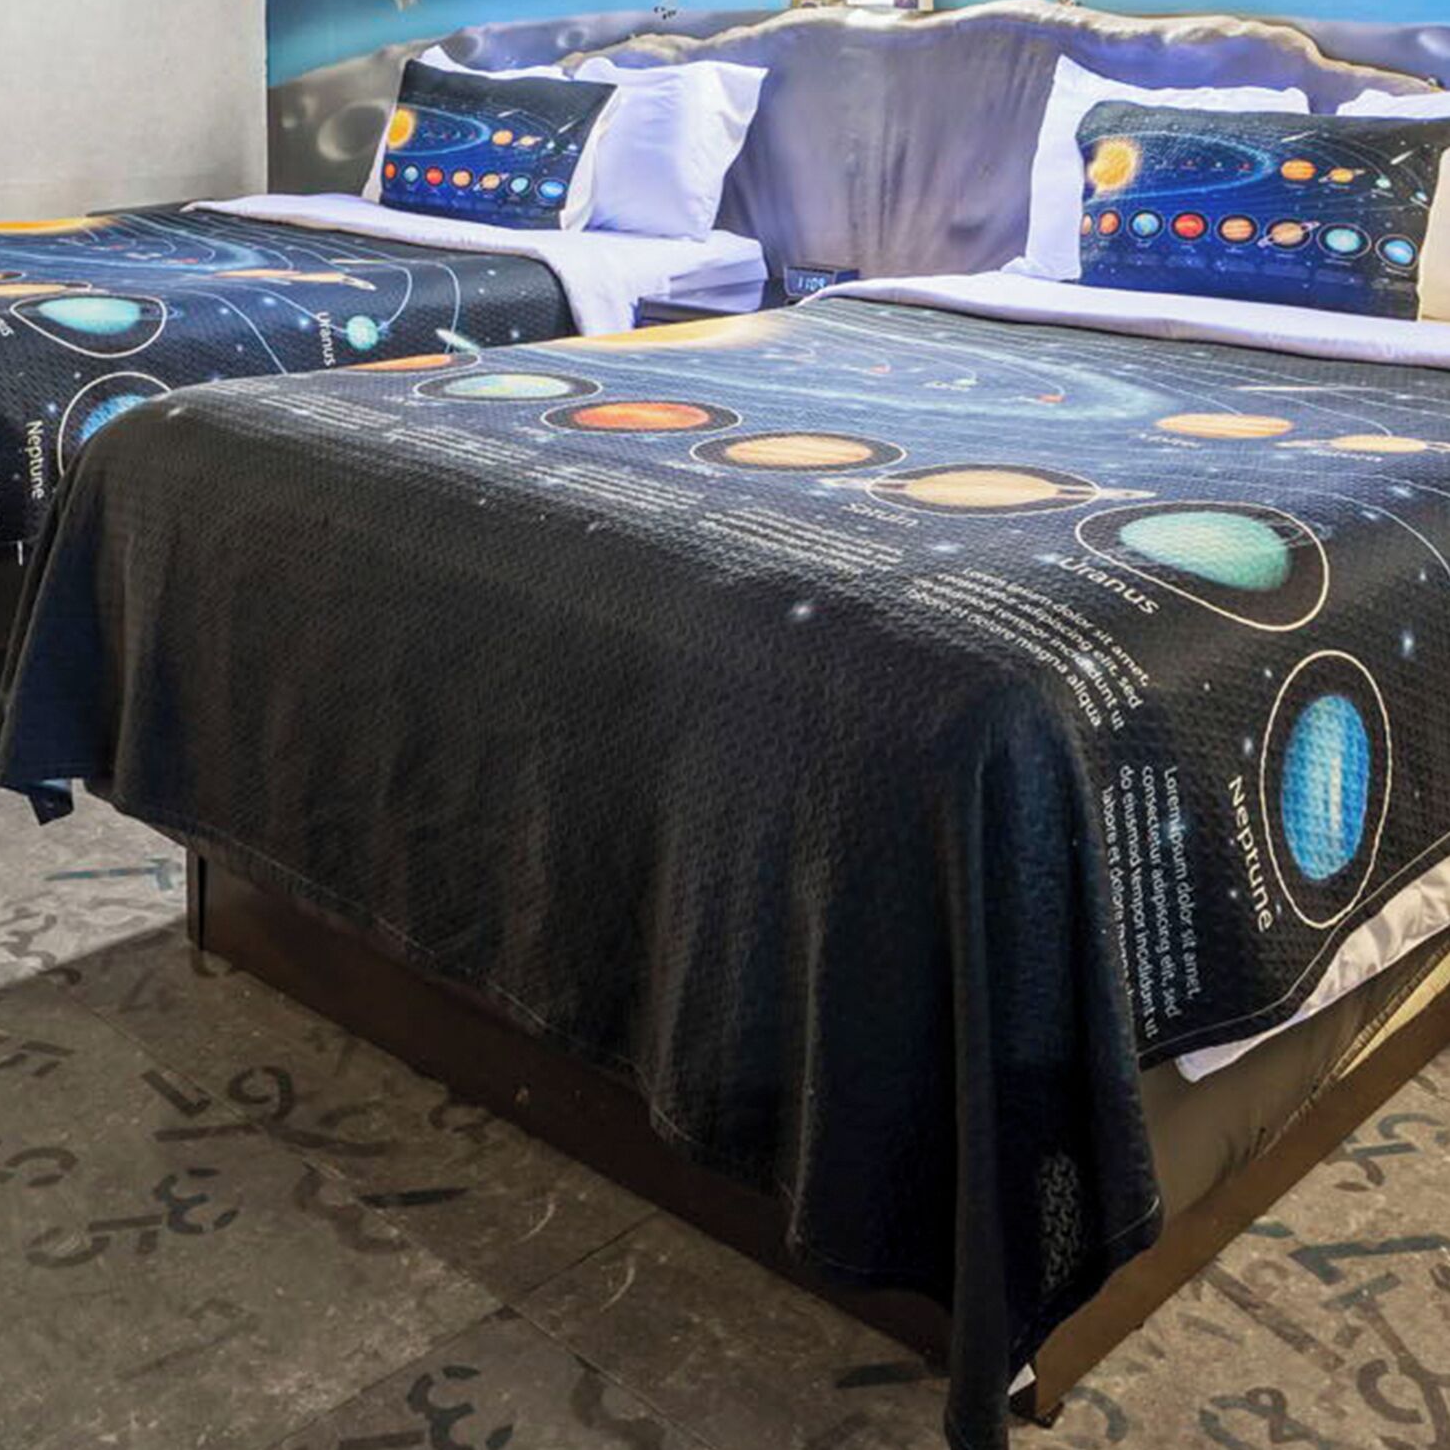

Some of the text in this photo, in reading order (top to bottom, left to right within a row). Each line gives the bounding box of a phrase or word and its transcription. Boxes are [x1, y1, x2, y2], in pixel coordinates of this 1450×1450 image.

[316, 311, 336, 366] Uranus
[25, 419, 46, 499] Neptune
[1058, 556, 1159, 615] Uranus
[1053, 603, 1095, 629] dolor
[1092, 629, 1113, 646] sit
[1015, 635, 1069, 675] magna
[1066, 674, 1102, 727] aliqua
[1118, 676, 1144, 709] sed
[1110, 710, 1125, 731] ut
[1119, 765, 1135, 790] do
[1130, 866, 1147, 929] tempor
[1228, 776, 1274, 933] Neptune
[1176, 881, 1195, 926] dolor
